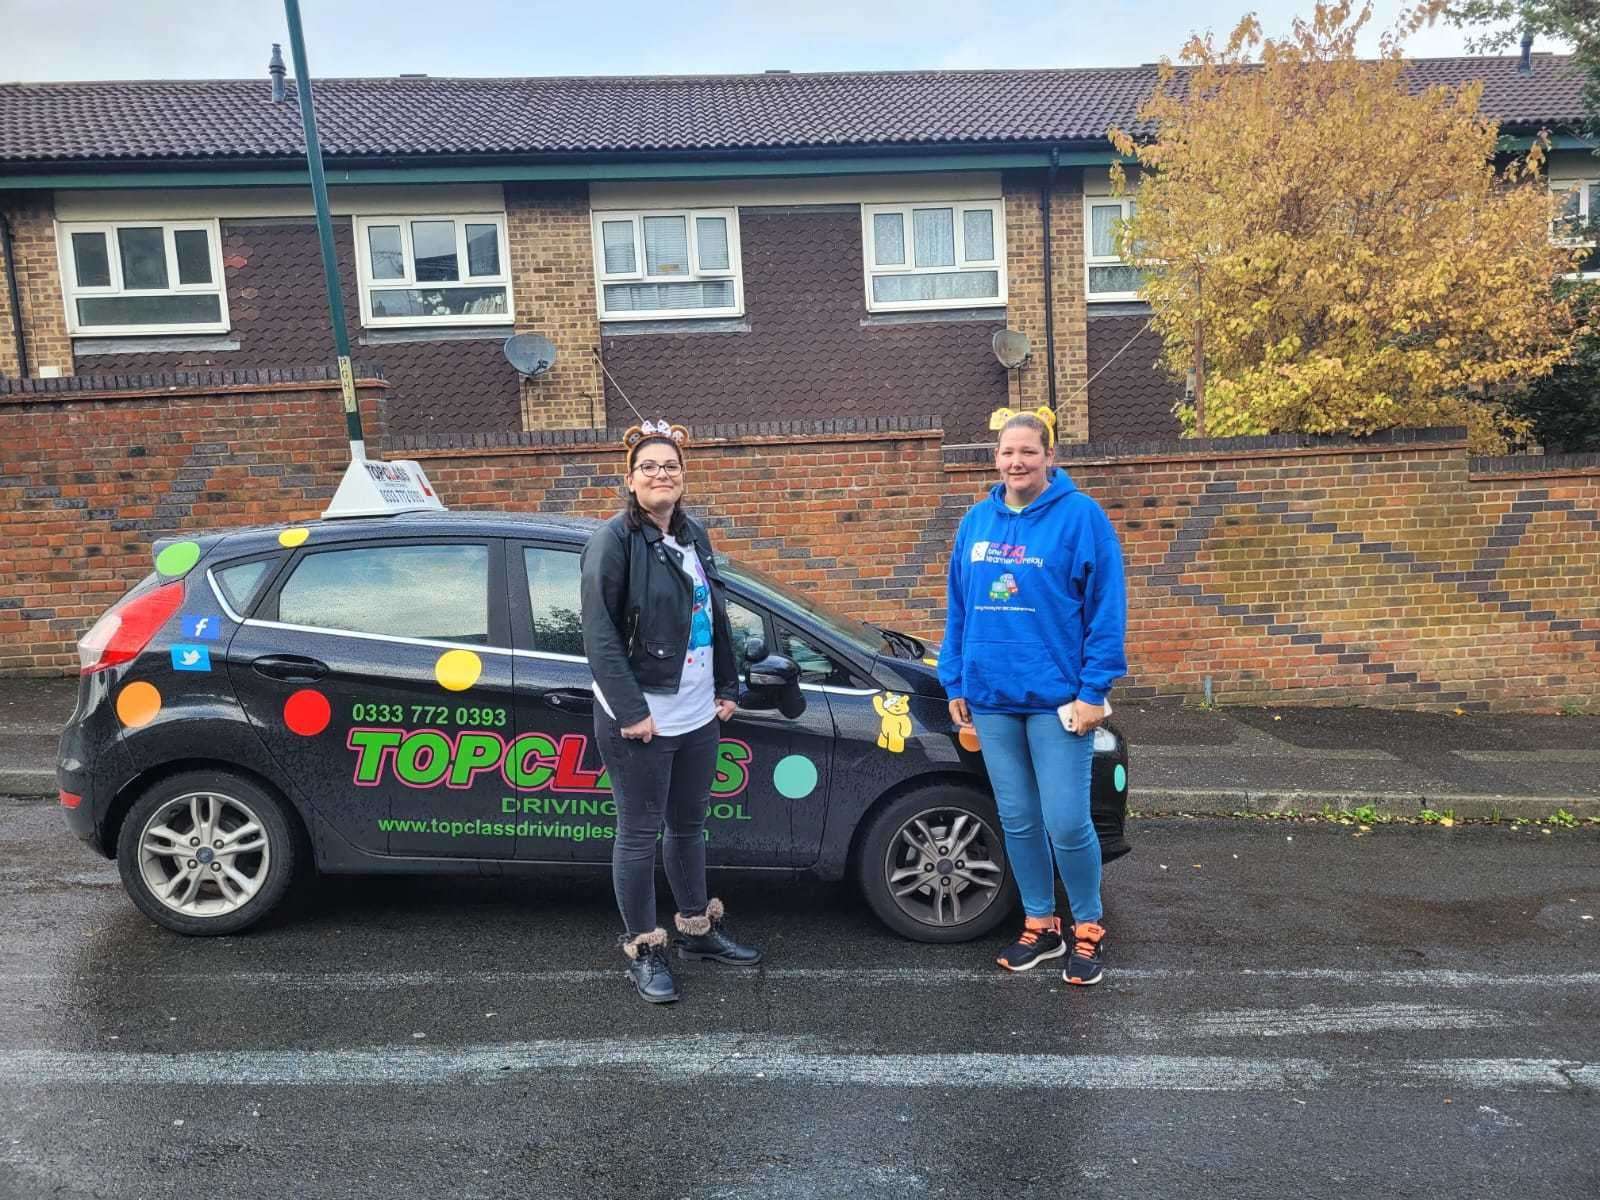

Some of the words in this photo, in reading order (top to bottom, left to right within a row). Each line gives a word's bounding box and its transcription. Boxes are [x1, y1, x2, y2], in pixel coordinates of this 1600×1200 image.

[352, 703, 404, 722] 0333
[410, 705, 449, 724] 772
[455, 707, 507, 726] 0393
[347, 727, 753, 798] TOPCLS
[501, 797, 619, 816] DRIVING
